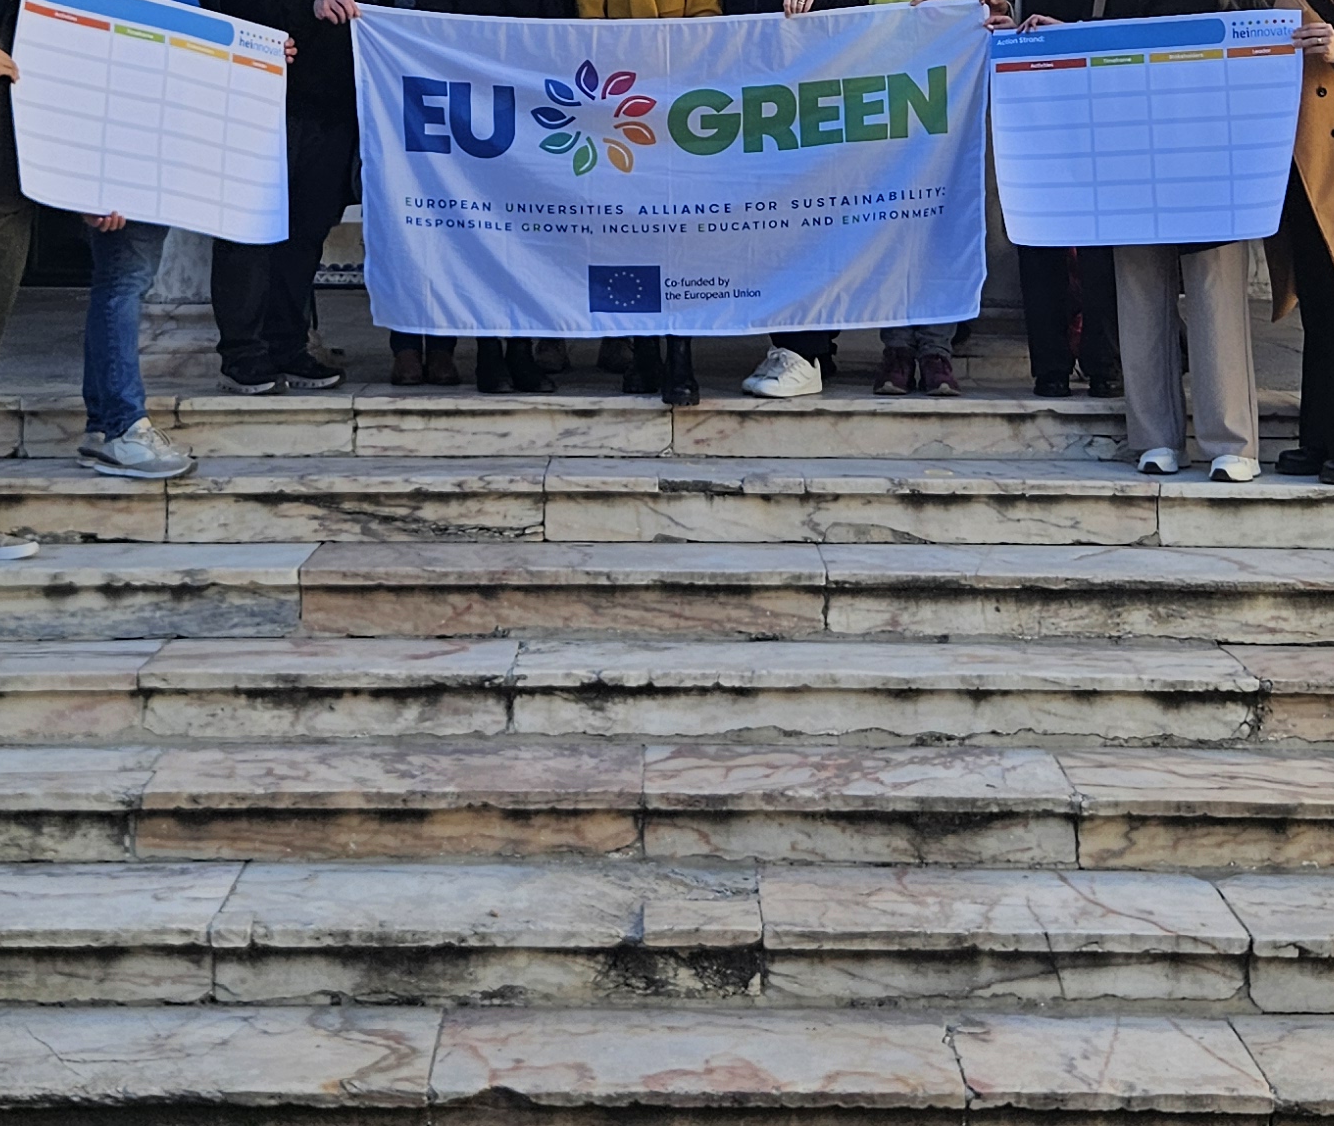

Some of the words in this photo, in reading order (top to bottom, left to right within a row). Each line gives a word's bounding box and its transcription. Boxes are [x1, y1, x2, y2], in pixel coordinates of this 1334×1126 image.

[996, 37, 1018, 46] Action
[1018, 35, 1046, 44] Strand:
[403, 76, 516, 159] EU
[667, 65, 949, 156] GREEN
[405, 196, 492, 212] EUROPEAN
[505, 202, 624, 215] UNIVERSITIES
[638, 202, 732, 215] ALLIANCE
[744, 200, 778, 213] FOR
[791, 185, 946, 210] SUSTAINABILITY:
[405, 216, 513, 232] RESPONSIBLE
[521, 223, 593, 235] GROWTH,
[602, 223, 688, 234] INCLUSIVE
[698, 219, 790, 233] EDUCATION
[801, 216, 834, 227] AND
[842, 205, 945, 225] ENVIRONMENT
[664, 276, 715, 288] Co-funded
[718, 277, 730, 288] by
[665, 291, 681, 300] the
[684, 290, 730, 301] European
[733, 288, 761, 299] Union
